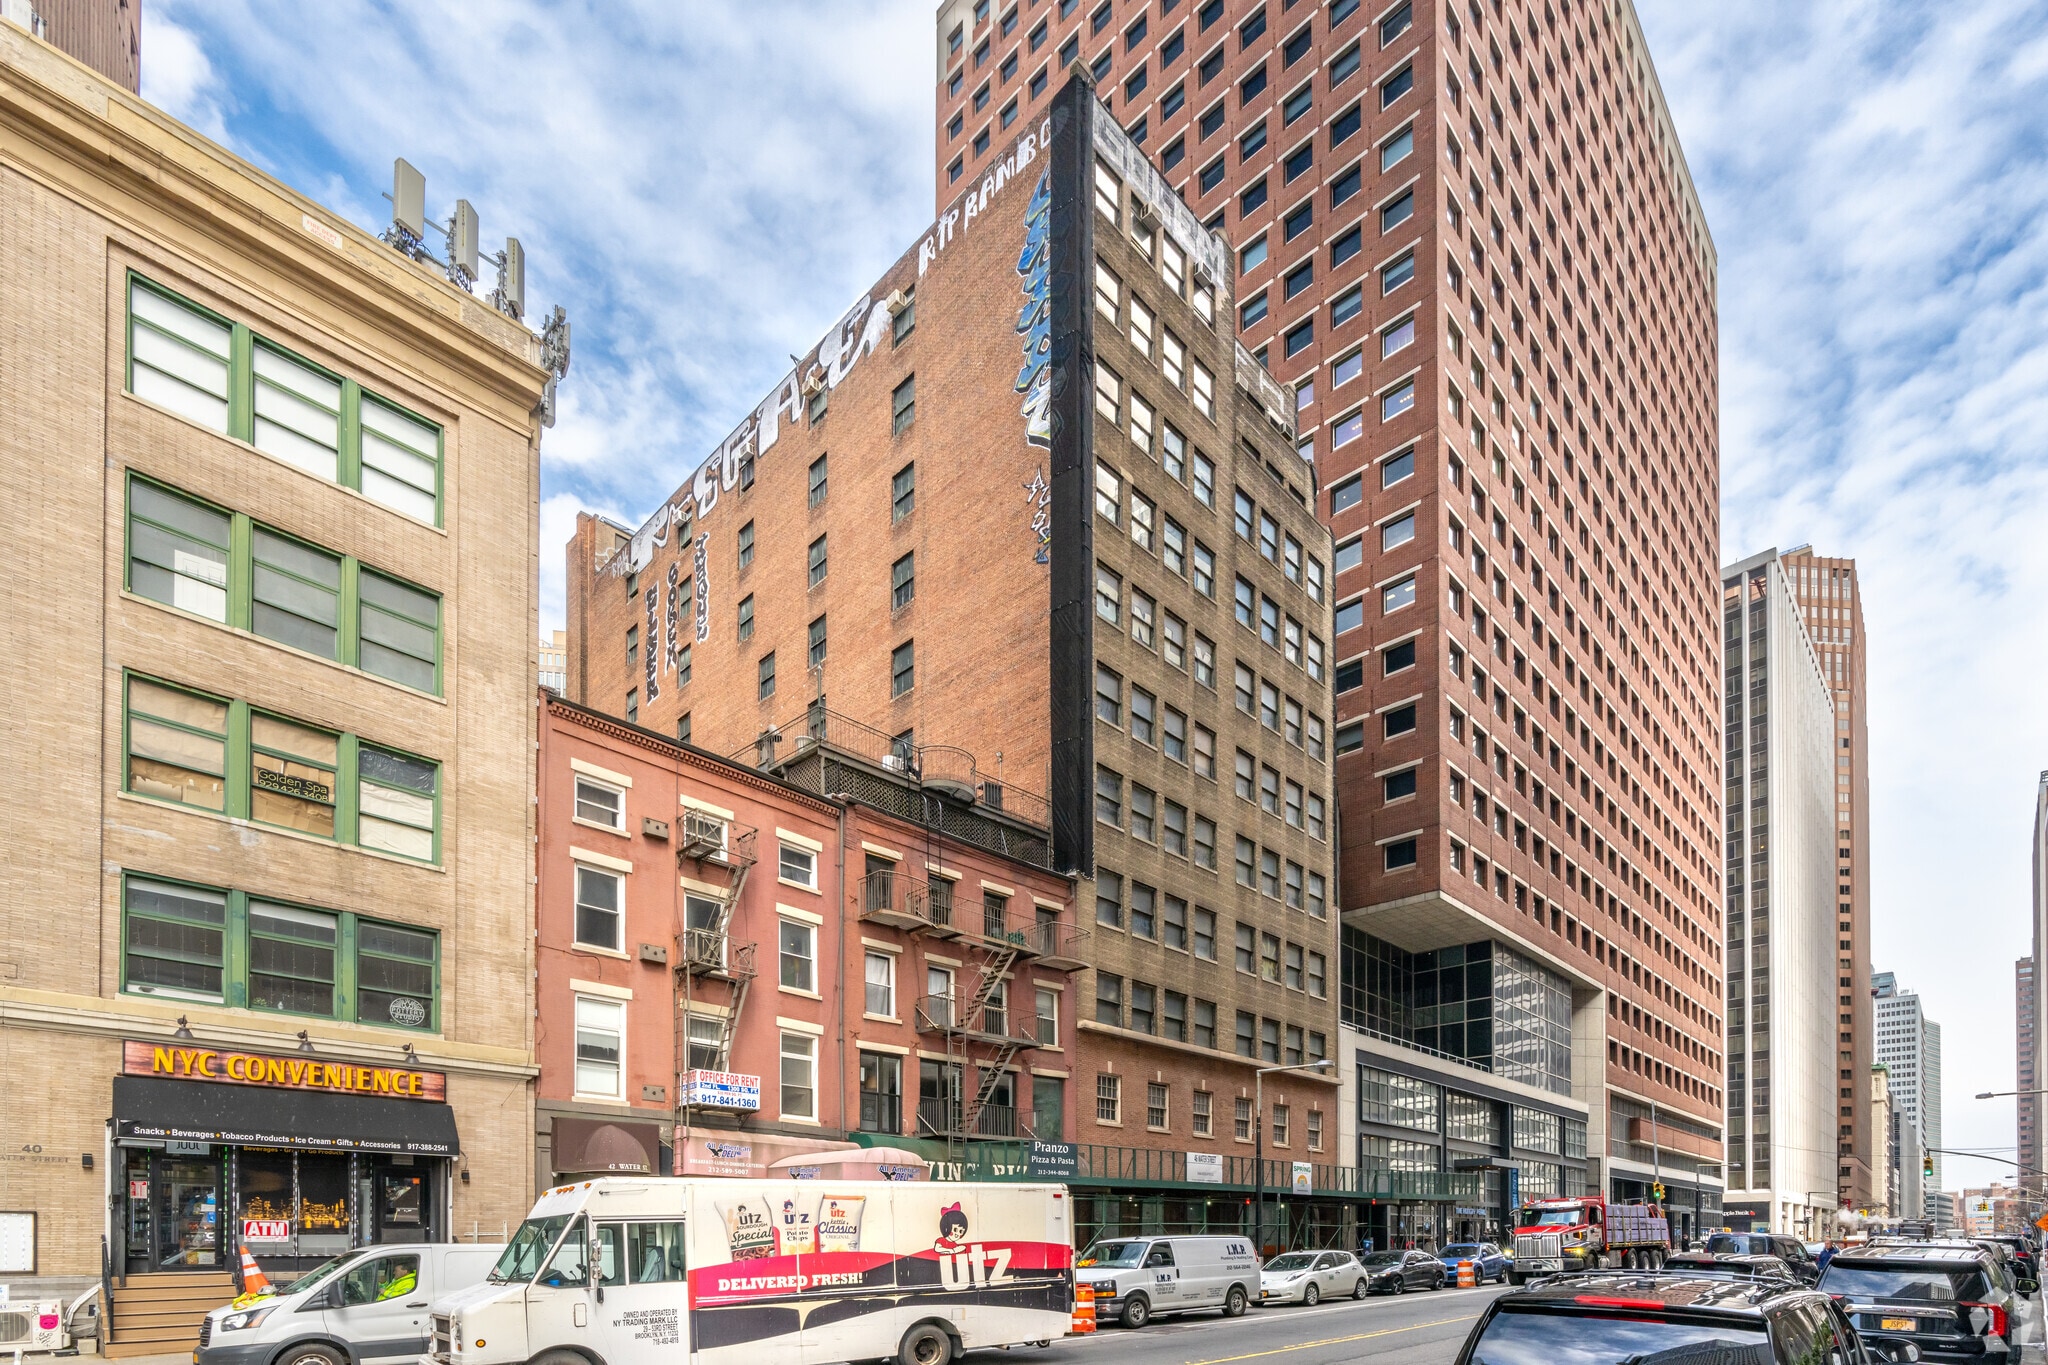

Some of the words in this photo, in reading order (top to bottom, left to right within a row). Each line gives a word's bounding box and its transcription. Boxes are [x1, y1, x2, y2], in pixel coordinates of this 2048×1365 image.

[918, 208, 960, 277] RIP
[258, 769, 302, 788] Golden
[305, 781, 327, 794] Spa
[391, 1006, 423, 1016] POTTERY
[153, 1047, 217, 1078] NYC
[227, 1055, 424, 1096] CONVENIENCE
[700, 1070, 724, 1085] OFFICE
[725, 1074, 740, 1086] FOR
[740, 1075, 759, 1088] RENT
[701, 1094, 757, 1108] 917-841-1360
[134, 1126, 165, 1136] Snacks
[171, 1128, 215, 1140] Beverages
[221, 1132, 254, 1141] Tobacco
[255, 1134, 290, 1143] Products
[294, 1136, 307, 1144] Ice
[308, 1137, 331, 1146] Cream
[336, 1138, 354, 1147] Gifts
[360, 1140, 401, 1149] Accessories
[407, 1143, 448, 1152] 917-388-2541
[22, 1144, 42, 1153] 40
[721, 1149, 738, 1158] DELI
[1034, 1141, 1069, 1154] Pranzo
[1031, 1155, 1050, 1164] Pizza
[1050, 1156, 1056, 1164] &
[1057, 1156, 1075, 1165] Pasta
[739, 1212, 762, 1225] utz
[830, 1209, 846, 1218] utz
[247, 1222, 285, 1236] ATM
[736, 1222, 768, 1230] SOURDOUGH
[818, 1221, 857, 1234] Classics
[939, 1244, 1015, 1291] utz
[718, 1275, 808, 1291] DELIVERED
[811, 1272, 863, 1286] FRESH!
[623, 1311, 639, 1319] OWNED
[649, 1309, 671, 1317] OPERATED
[671, 1308, 678, 1316] BY
[622, 1318, 648, 1326] TRADING
[649, 1317, 666, 1325] MARK
[667, 1316, 678, 1324] LLC
[662, 1323, 678, 1331] STREET
